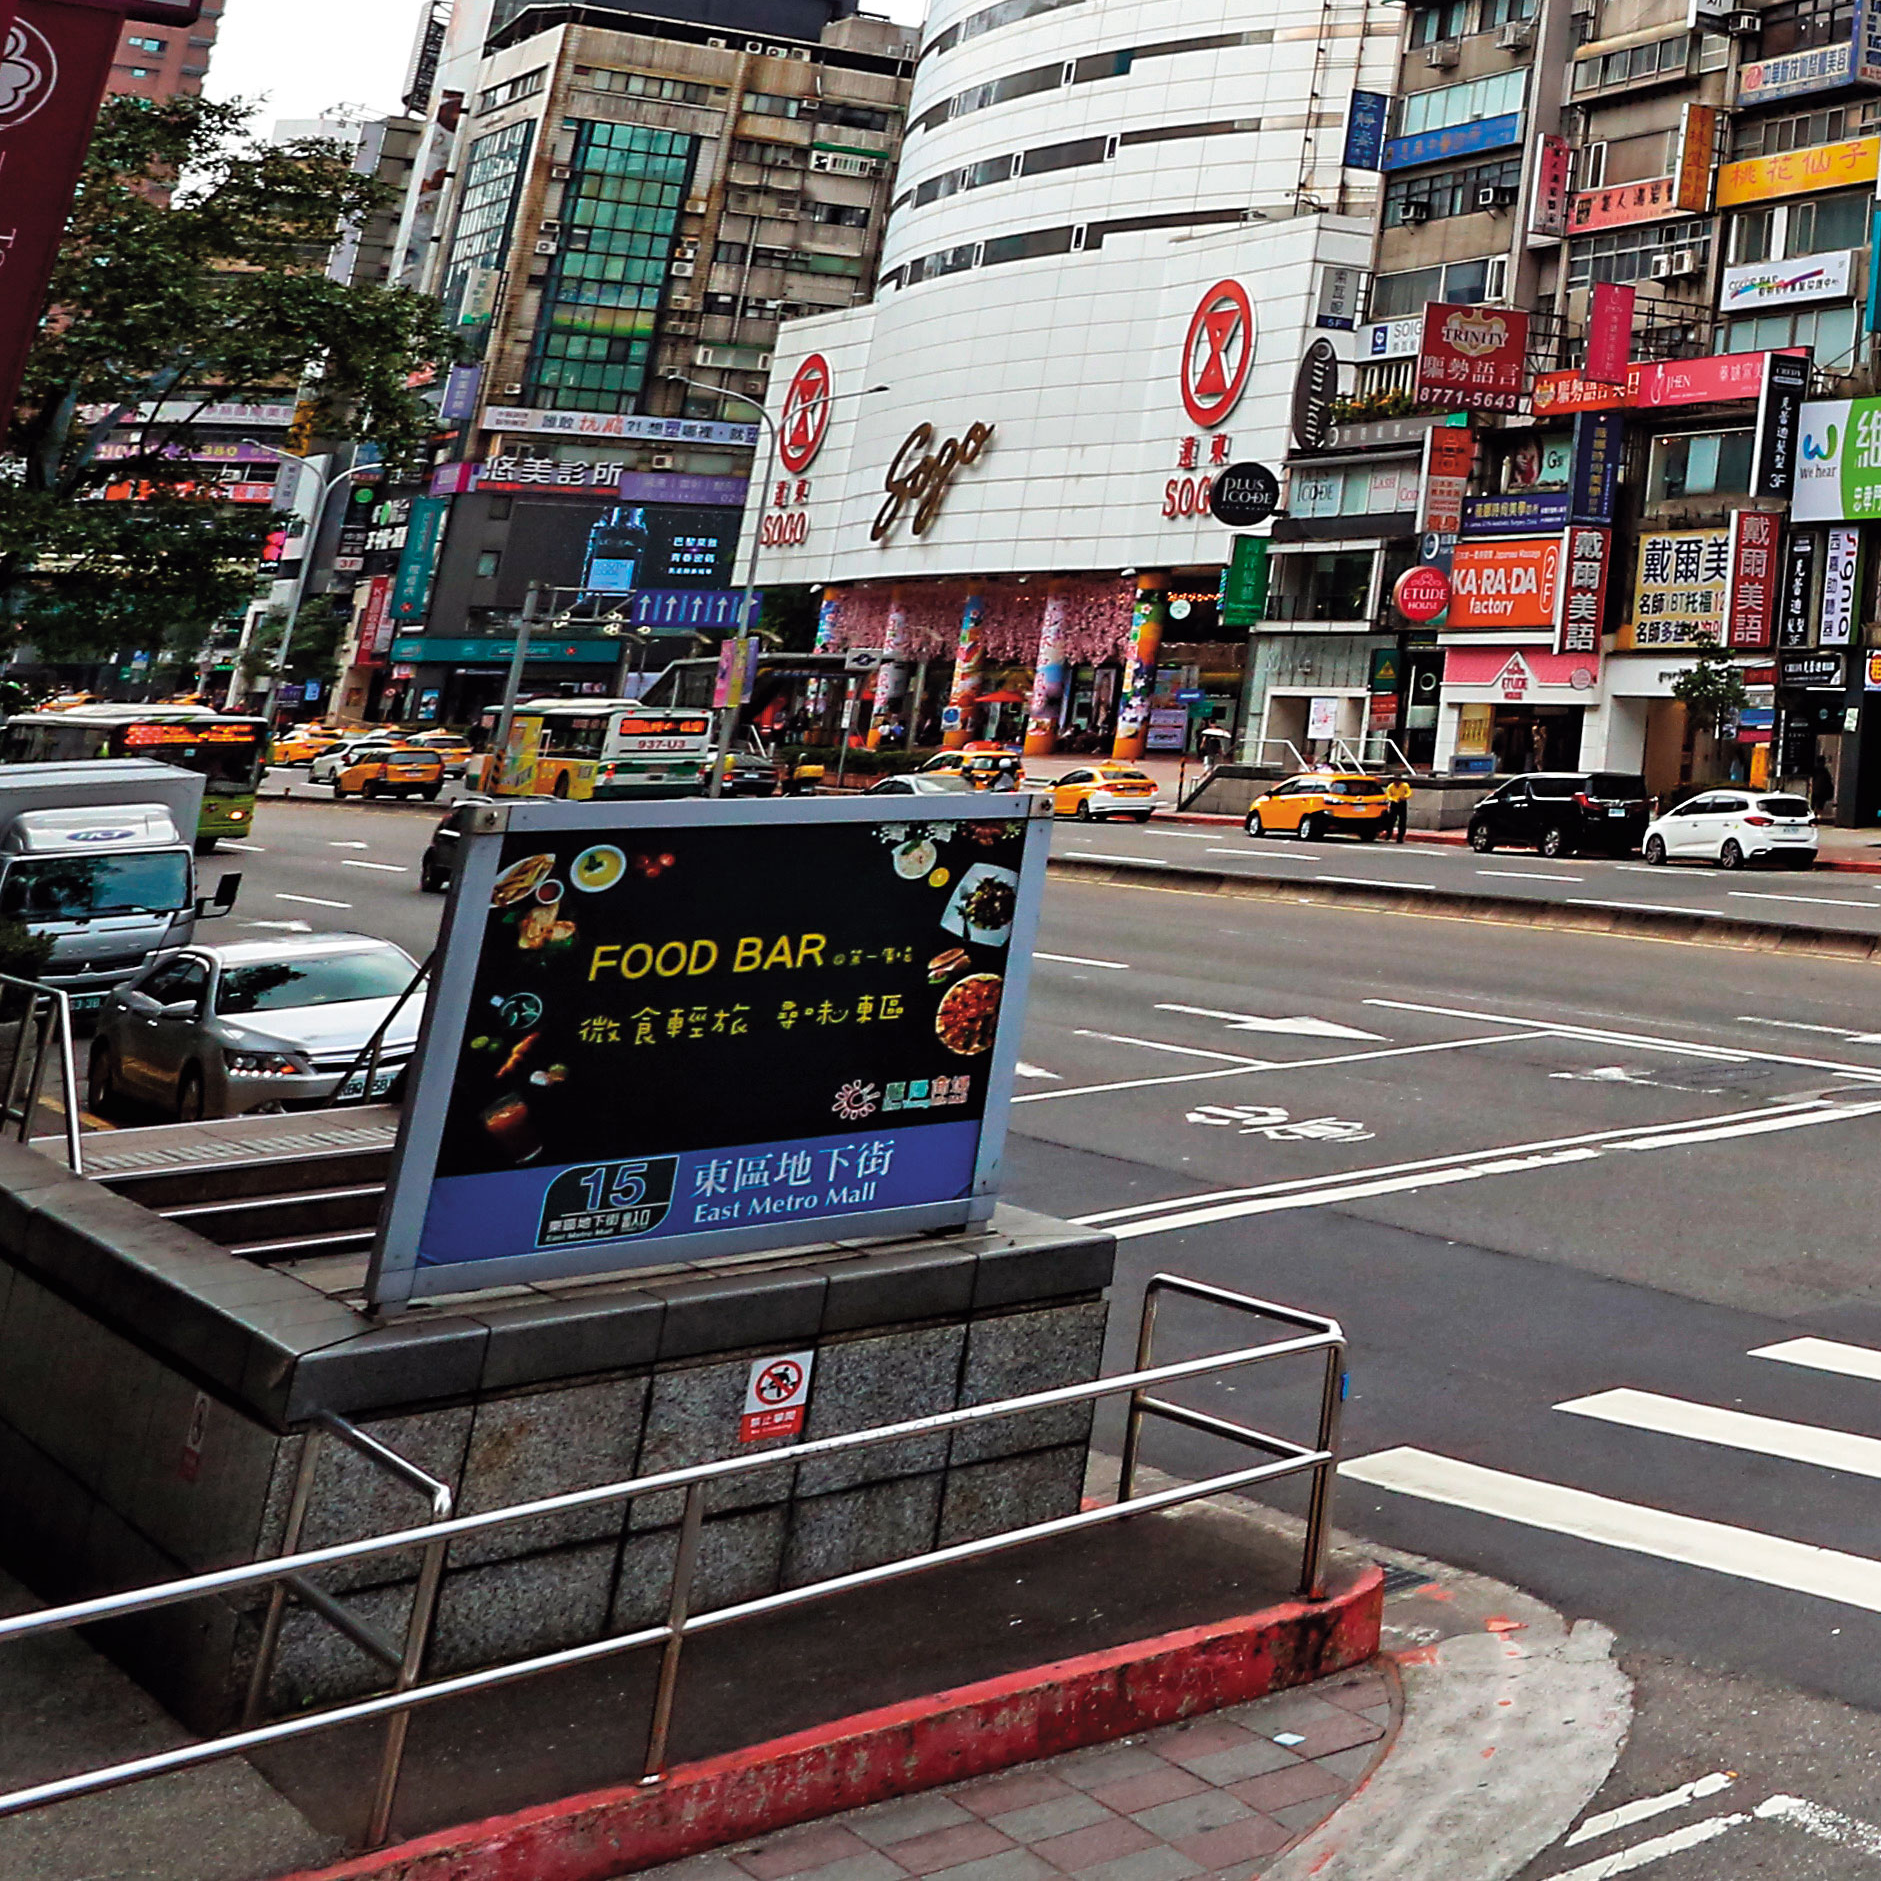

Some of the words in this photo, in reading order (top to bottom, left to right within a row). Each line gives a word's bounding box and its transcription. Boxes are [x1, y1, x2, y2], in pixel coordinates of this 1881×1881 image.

[1729, 141, 1868, 189] 桃花仙子
[1443, 326, 1508, 347] TRINITY
[1420, 386, 1517, 410] 8771-5643
[1769, 473, 1787, 489] 3F
[1800, 463, 1815, 479] We
[1816, 463, 1837, 479] hear
[1162, 476, 1213, 518] SOG
[760, 510, 811, 548] SOGO
[340, 559, 356, 568] 3F
[1402, 587, 1447, 600] ETUDE
[1566, 531, 1604, 651] 戴爾美語
[1734, 517, 1771, 643] 戴爾美語
[1838, 533, 1858, 638] signia
[1407, 601, 1438, 610] HOUSE
[1469, 596, 1514, 616] factory
[1789, 634, 1801, 646] 3F
[588, 938, 719, 982] FOOD
[732, 931, 827, 973] BAR
[690, 1140, 895, 1198] 東區地下街
[580, 1162, 648, 1212] 15
[693, 1202, 740, 1225] East
[747, 1191, 818, 1218] Metro
[825, 1182, 876, 1208] Mall
[568, 1229, 593, 1240] Metro
